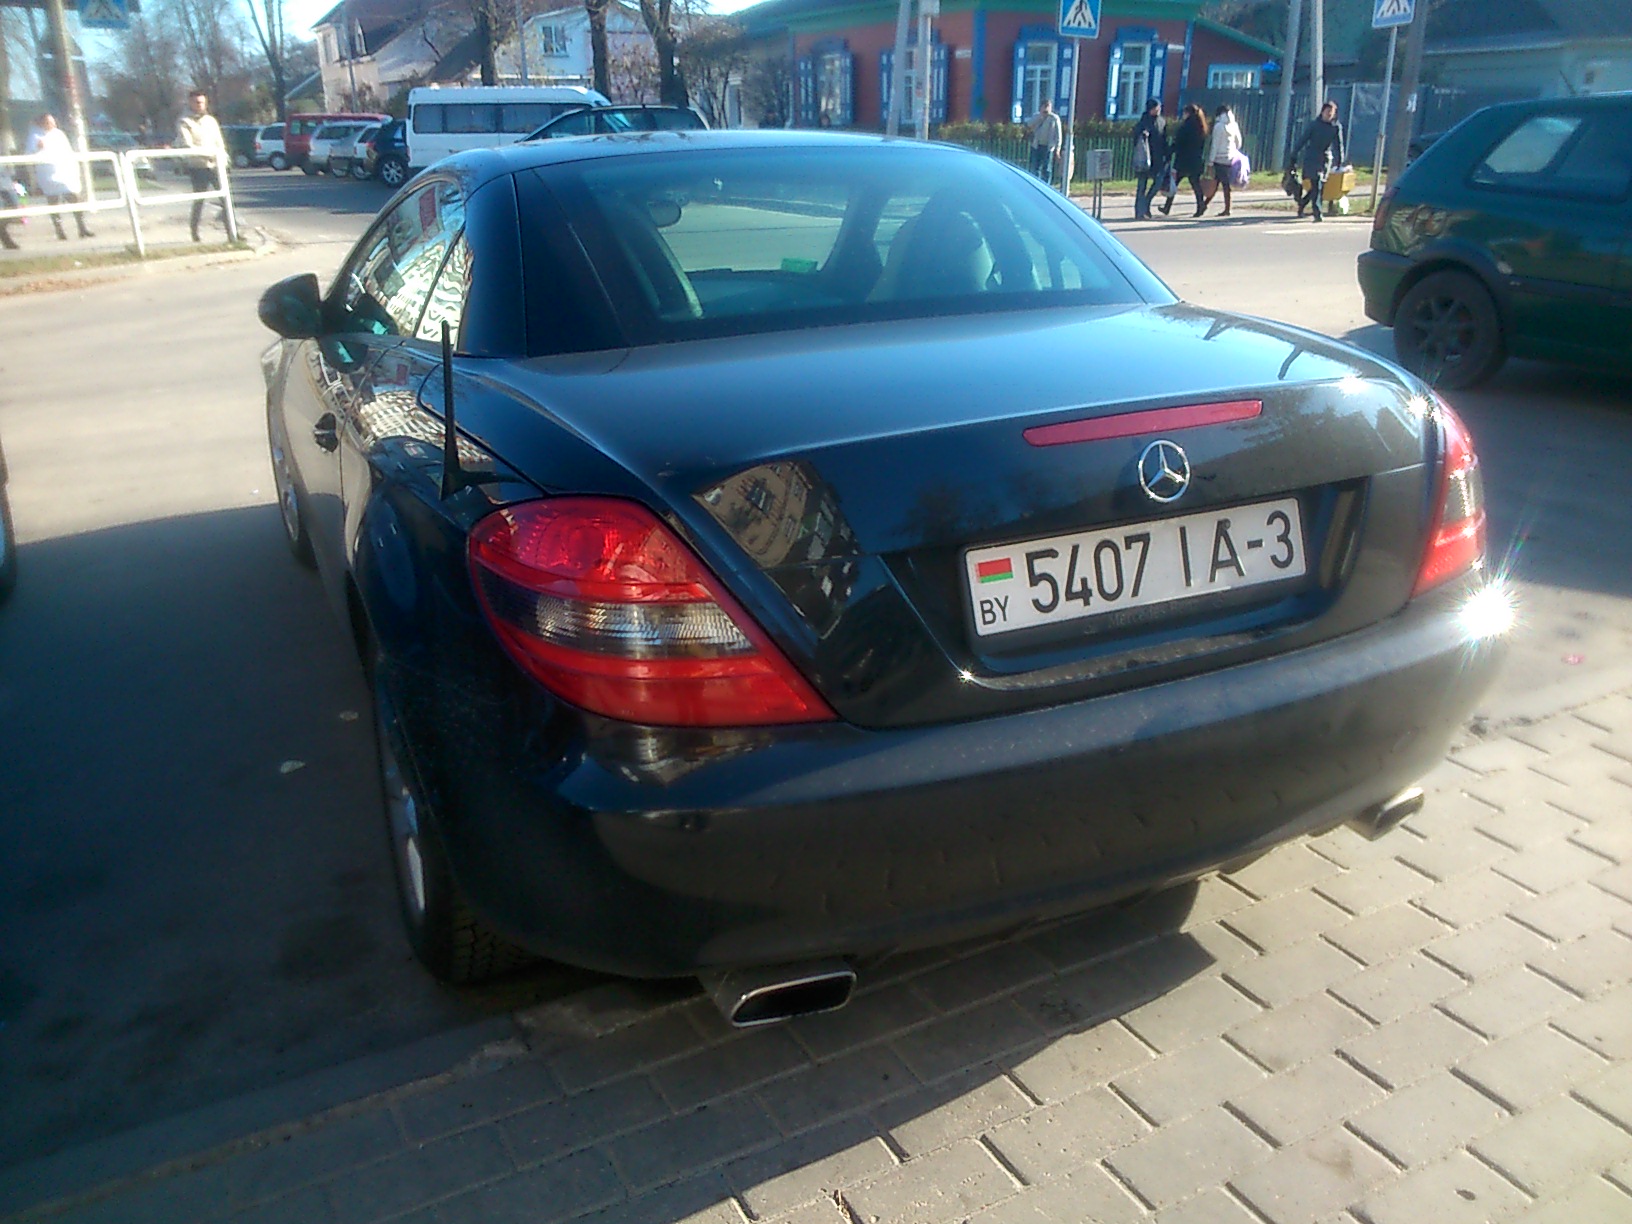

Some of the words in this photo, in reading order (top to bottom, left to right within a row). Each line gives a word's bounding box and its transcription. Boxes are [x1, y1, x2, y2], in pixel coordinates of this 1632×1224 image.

[1025, 532, 1151, 614] 5407
[1179, 510, 1294, 587] IA-3
[979, 595, 1009, 626] BY
